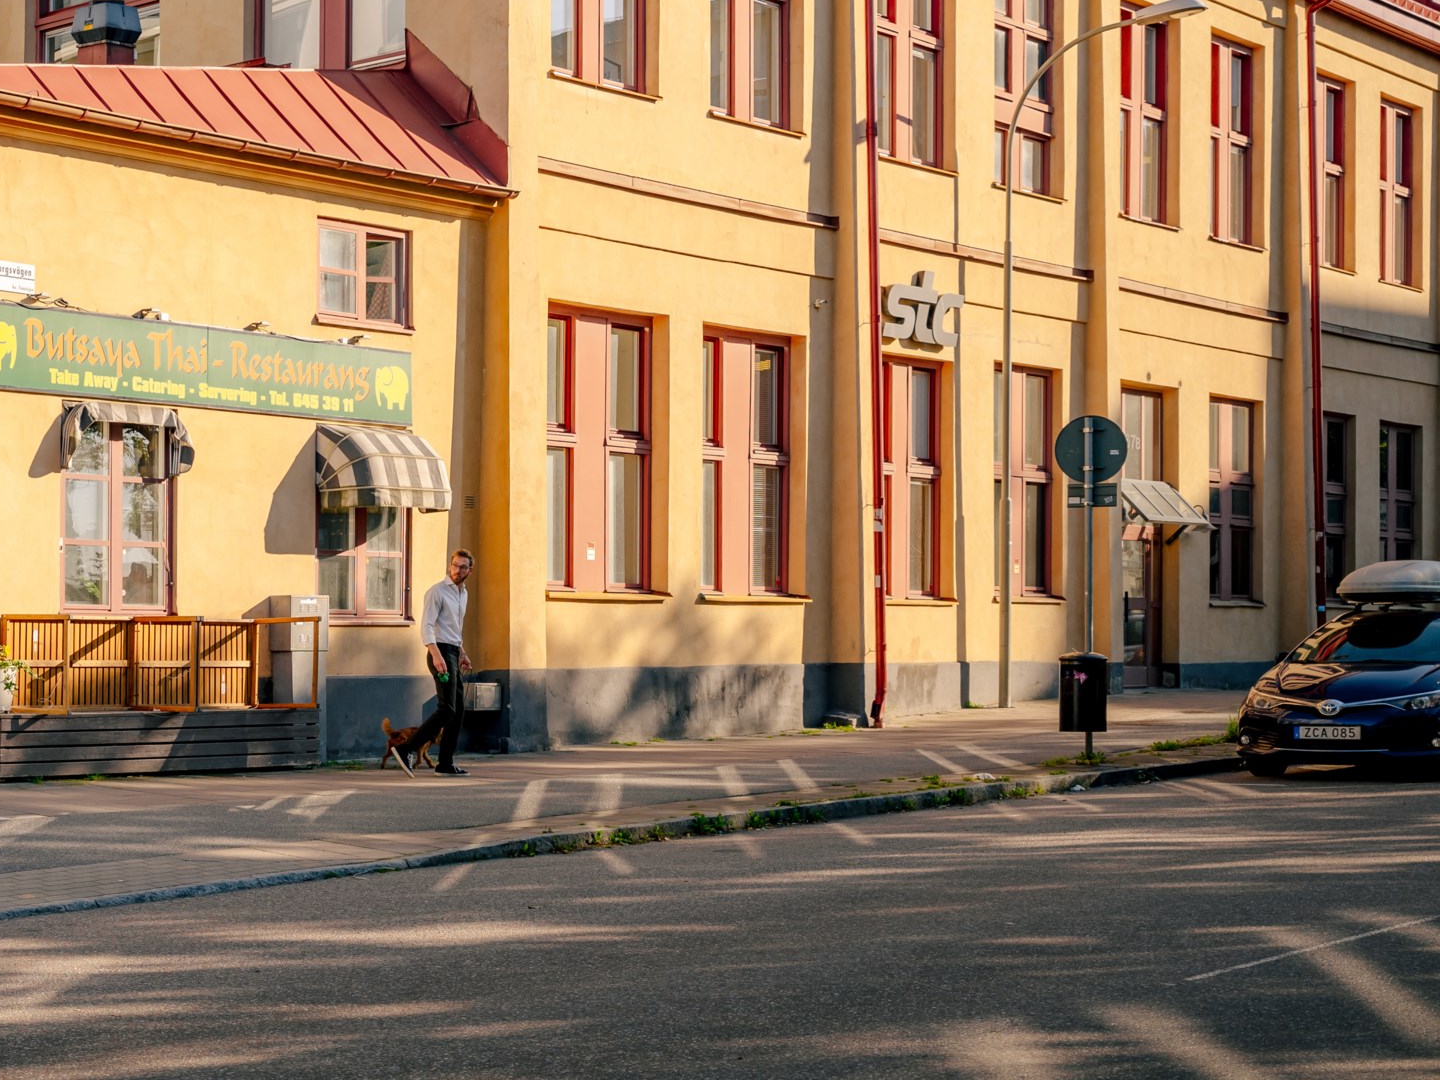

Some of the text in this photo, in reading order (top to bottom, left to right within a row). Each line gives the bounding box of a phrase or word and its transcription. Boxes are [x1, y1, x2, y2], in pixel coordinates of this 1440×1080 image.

[882, 270, 965, 347] stc
[24, 318, 141, 377] Butsaya
[229, 340, 371, 403] Restaurang
[49, 368, 80, 386] Take
[83, 371, 120, 392] Away
[132, 375, 186, 400] Catering
[198, 382, 258, 407] Servering
[268, 390, 290, 407] Tel.
[292, 392, 320, 411] 645
[322, 396, 340, 413] 39
[342, 397, 355, 414] 11
[1304, 728, 1356, 738] ZCA 085
